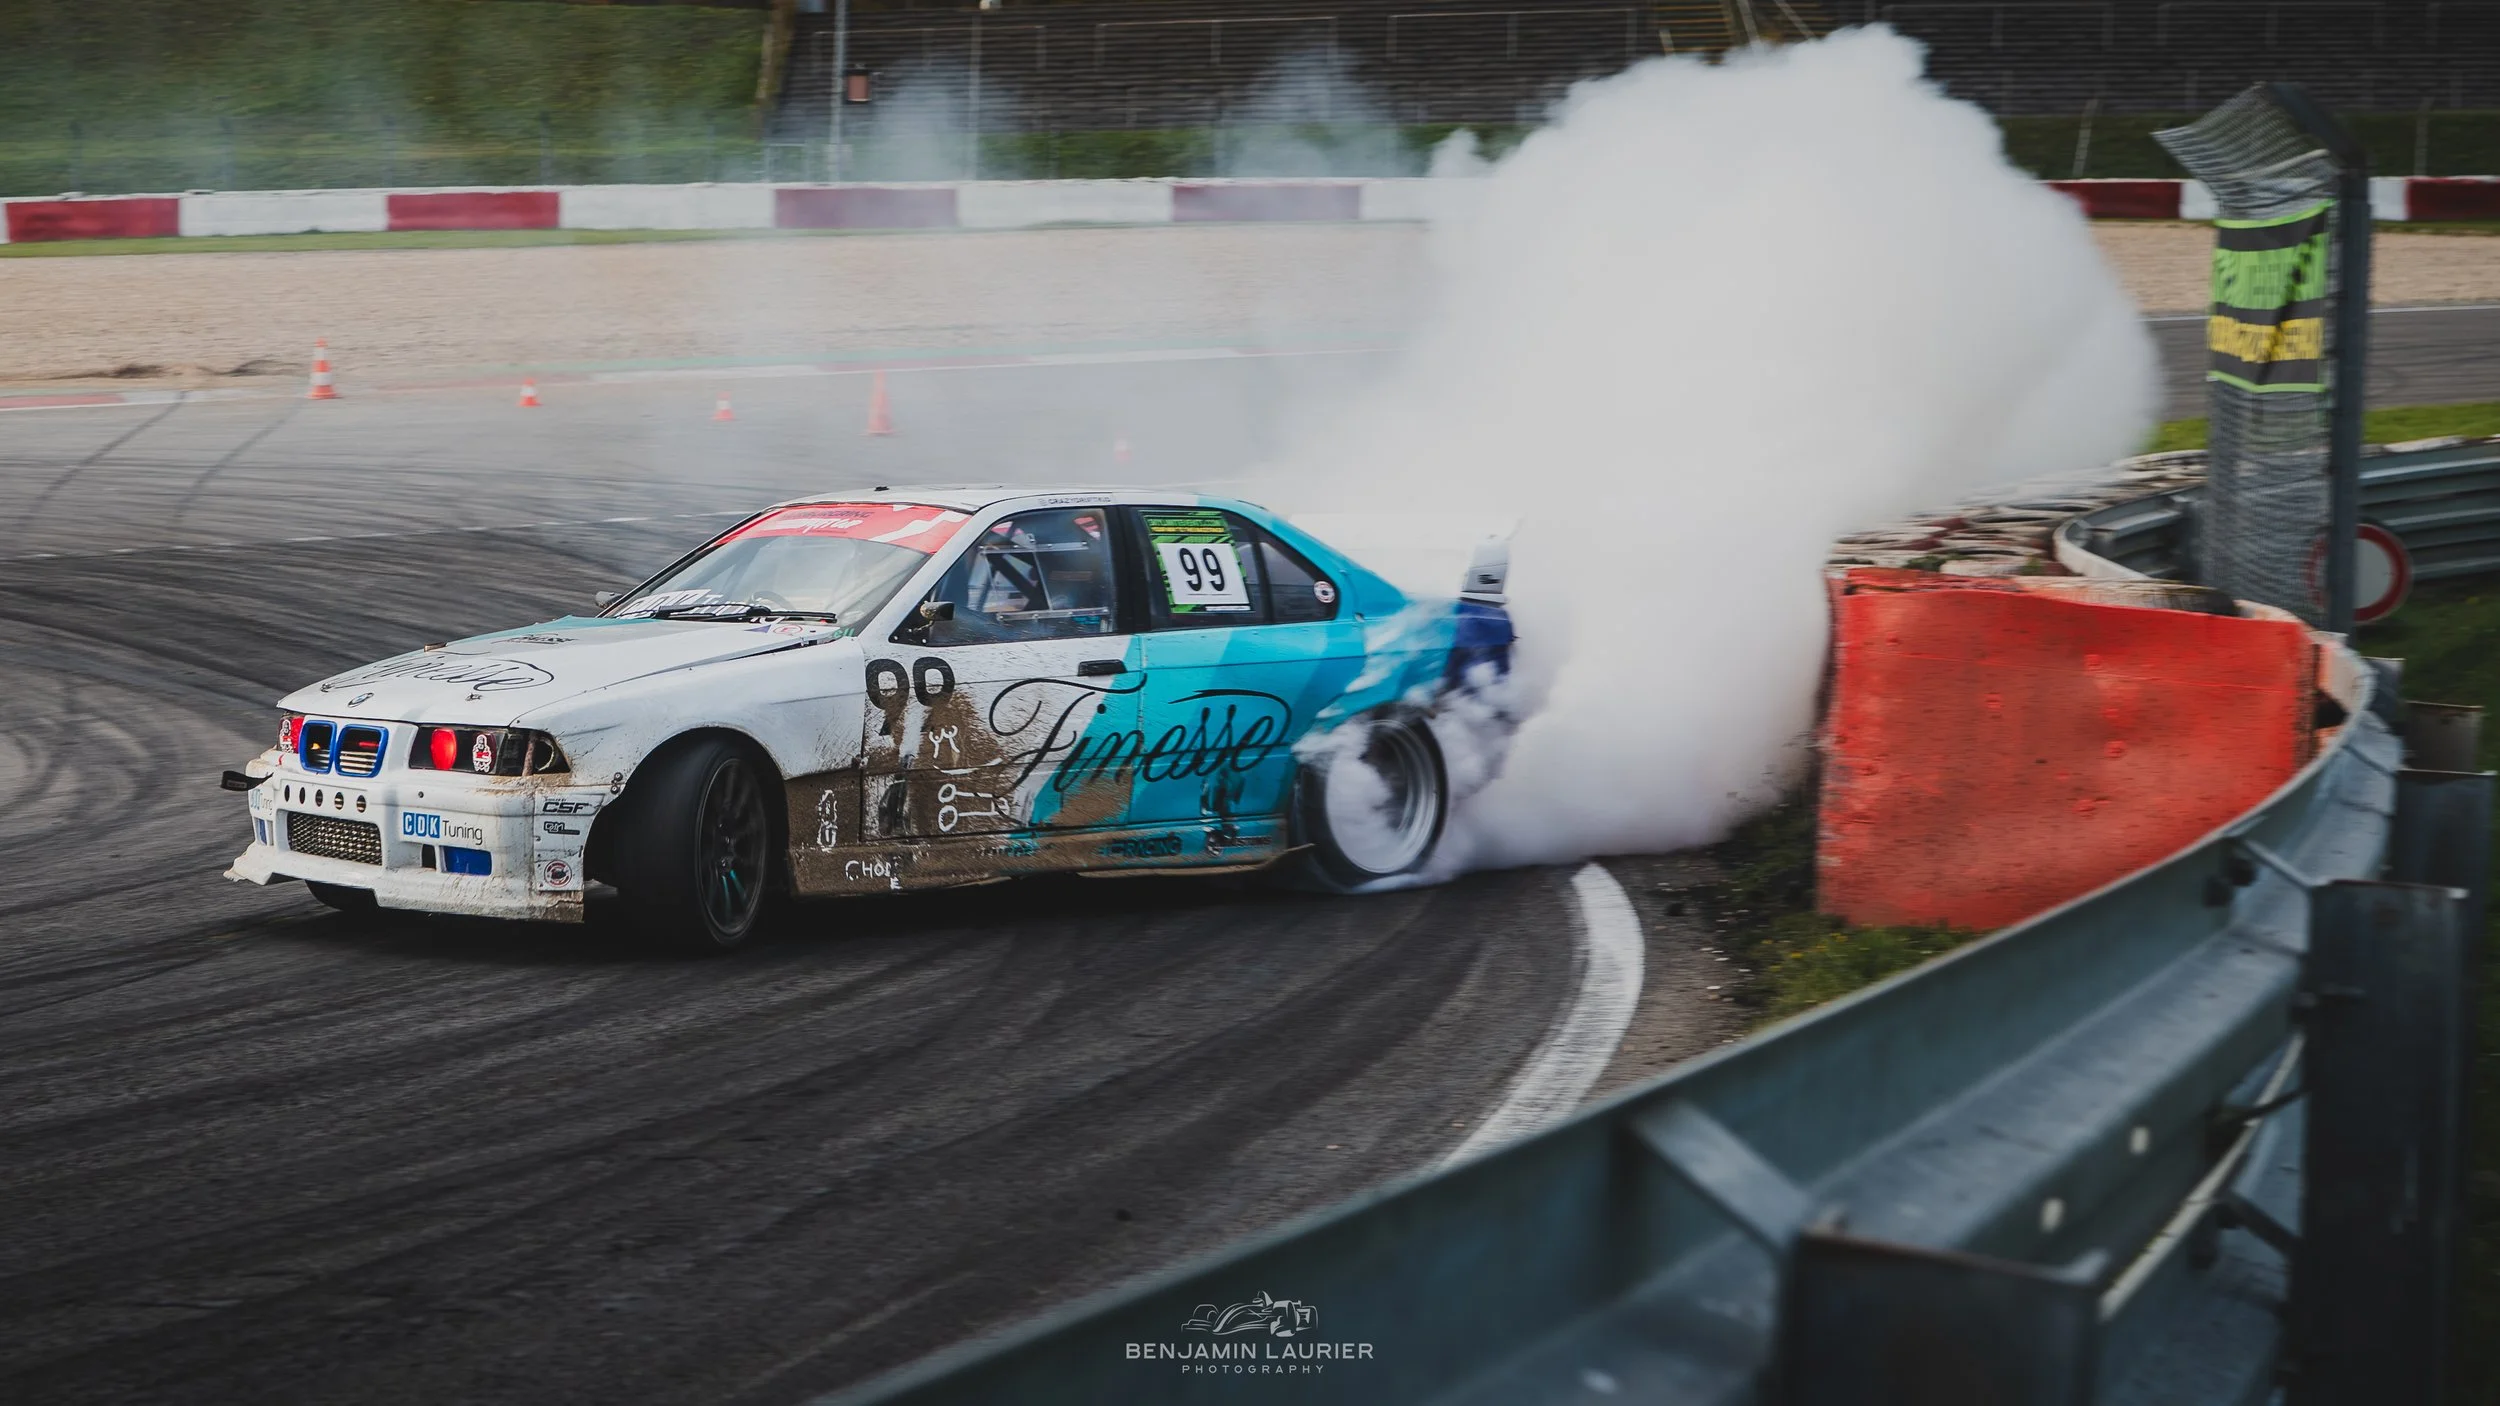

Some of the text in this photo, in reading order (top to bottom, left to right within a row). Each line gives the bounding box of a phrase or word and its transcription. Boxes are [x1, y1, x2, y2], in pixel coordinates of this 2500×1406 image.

[1179, 547, 1225, 592] 99
[989, 673, 1292, 793] Finesse
[542, 801, 590, 814] CSF
[403, 813, 483, 845] CDK Tuning
